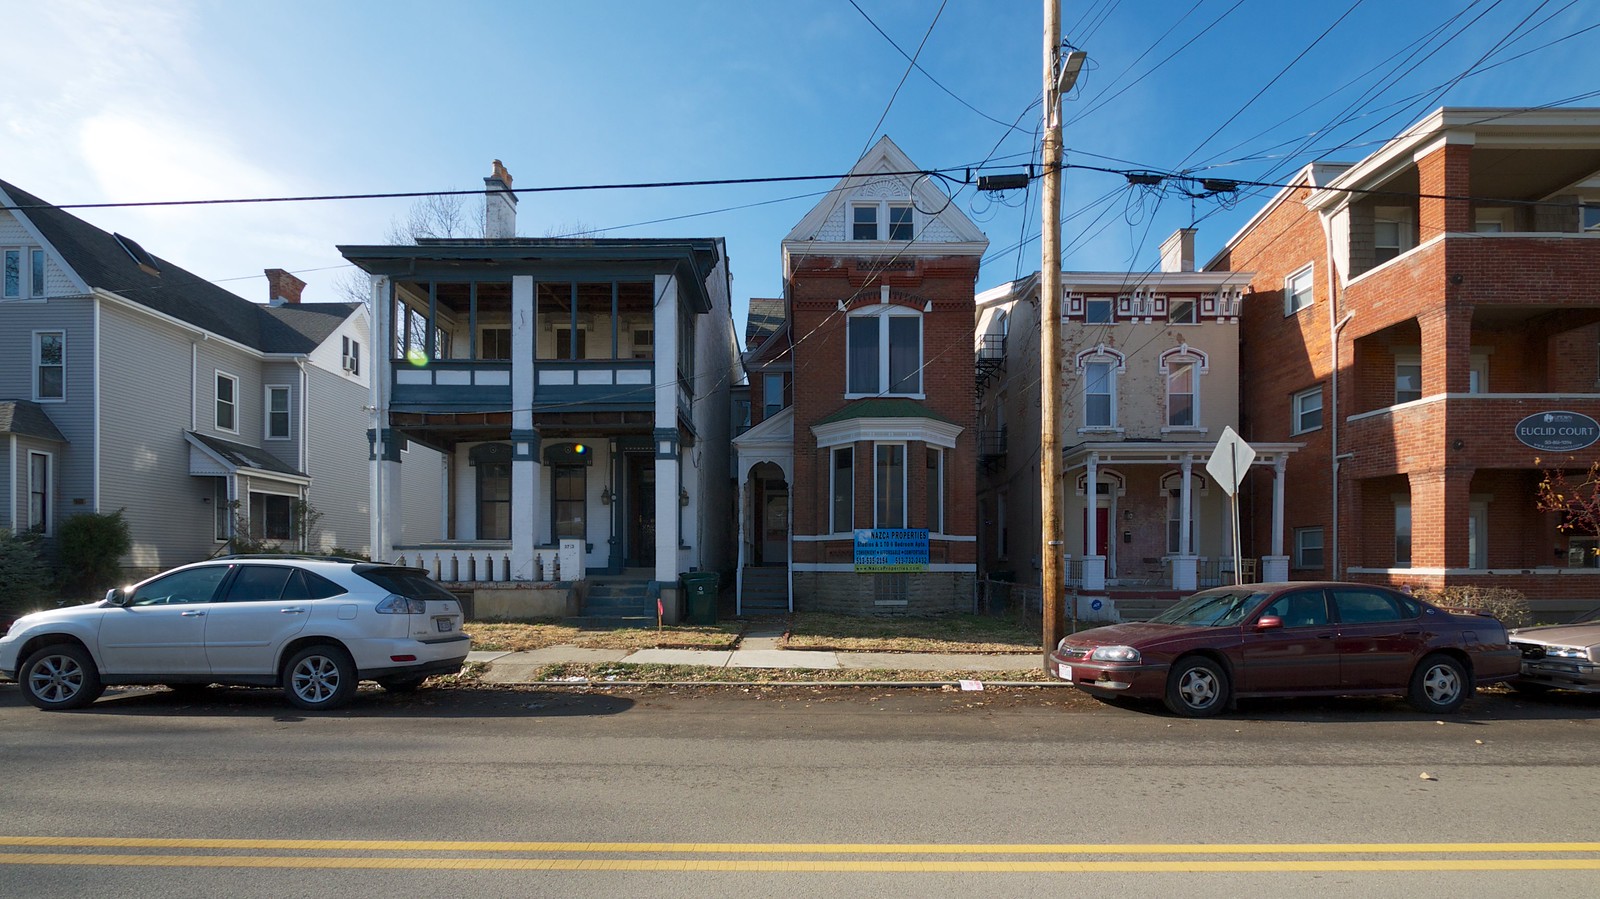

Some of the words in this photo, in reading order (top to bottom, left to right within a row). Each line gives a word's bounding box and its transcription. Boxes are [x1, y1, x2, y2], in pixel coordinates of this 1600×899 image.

[1521, 427, 1556, 436] EUCLID
[1558, 427, 1594, 436] COURT
[870, 531, 889, 540] NAZCA
[891, 531, 927, 540] PROPERTIES
